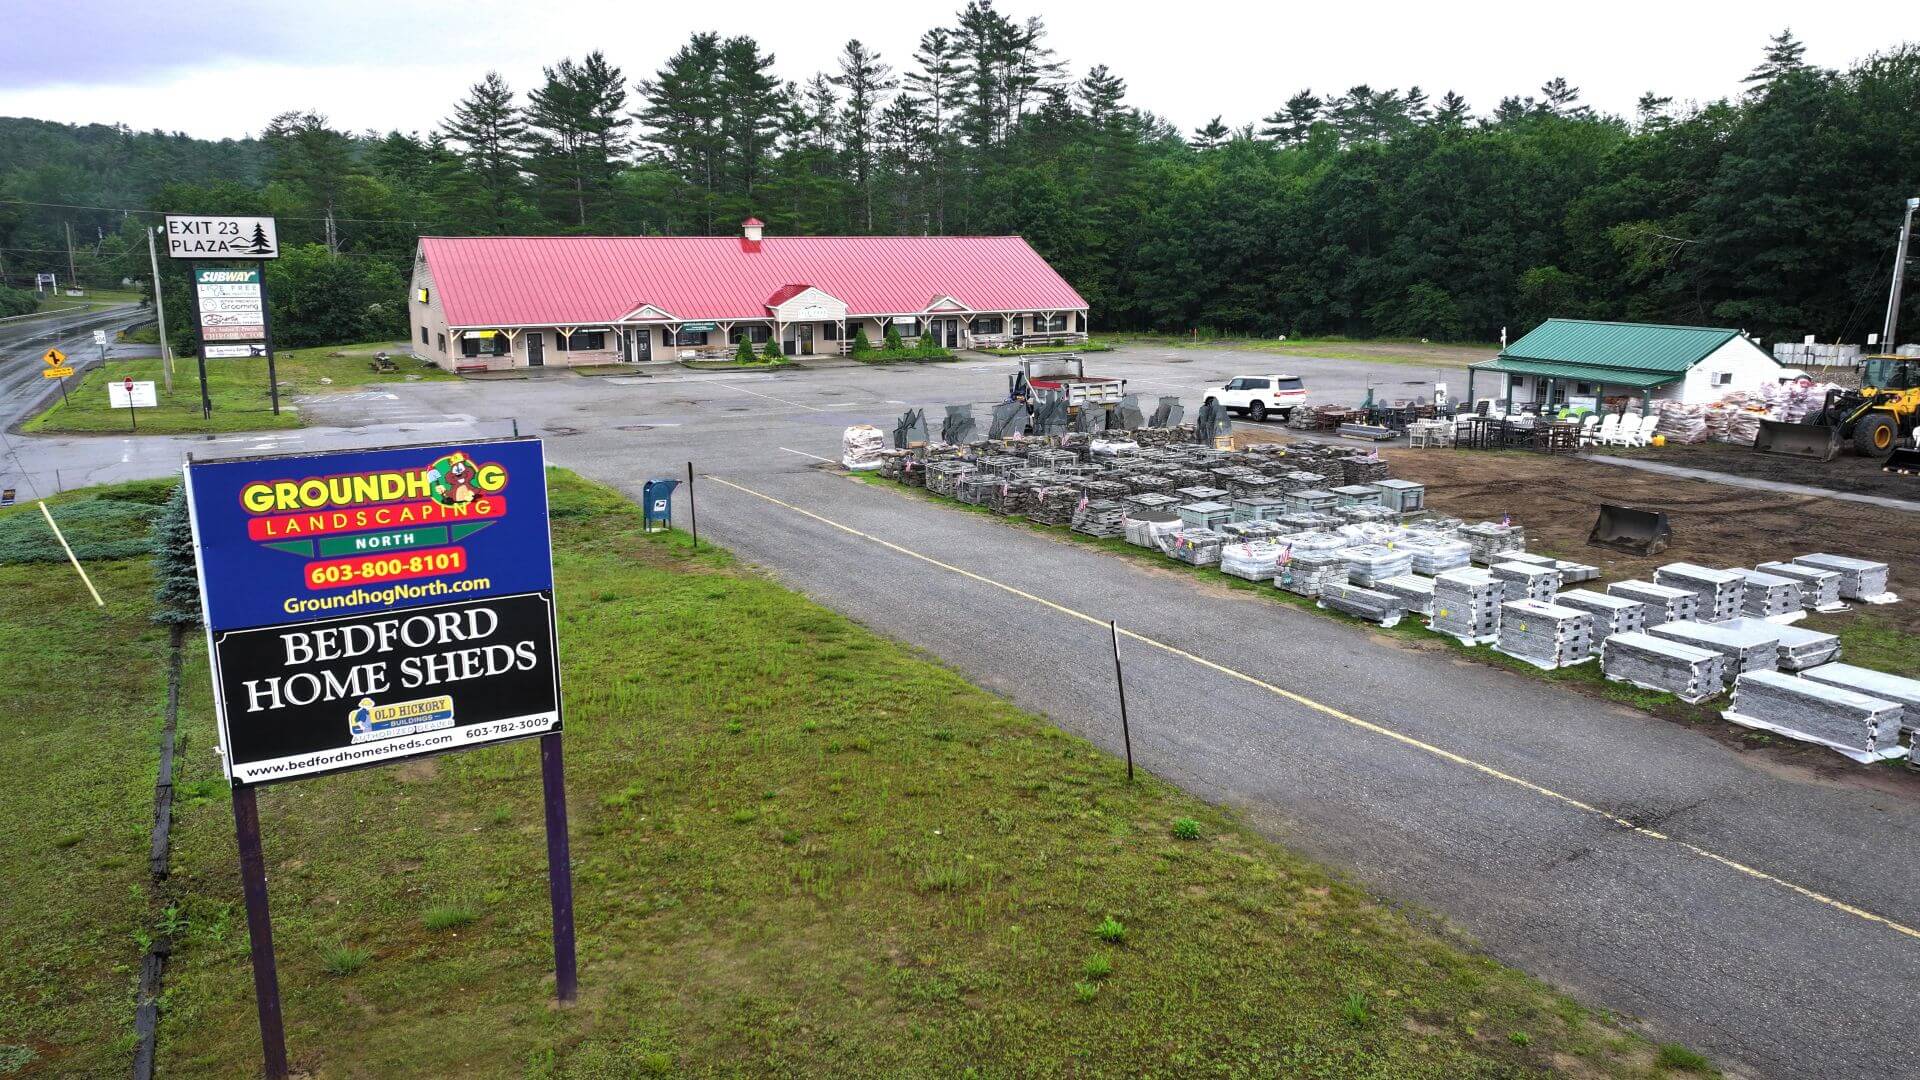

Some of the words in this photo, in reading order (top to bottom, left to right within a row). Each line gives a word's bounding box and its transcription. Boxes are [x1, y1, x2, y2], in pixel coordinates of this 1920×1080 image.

[169, 221, 212, 234] EXIT
[218, 222, 239, 235] 23
[171, 240, 229, 252] PLAZA
[199, 271, 256, 282] SUBWAY
[266, 500, 492, 536] LANDSCAPING
[355, 533, 415, 550] NORTH
[311, 552, 461, 584] 603-800-8101
[284, 577, 491, 614] GroundhogNorth.com
[280, 607, 498, 666] BEDFORD
[242, 661, 390, 712] HOME
[401, 640, 538, 688] SHEDS
[374, 707, 396, 721] OLD
[399, 699, 446, 717] HICKORY
[390, 714, 433, 727] BUILDINGS
[353, 726, 415, 741] AUTHORIZED
[416, 720, 454, 731] DEALER
[247, 733, 453, 777] www.bedfordhomesheds.com
[466, 717, 549, 739] 603-782-3009
